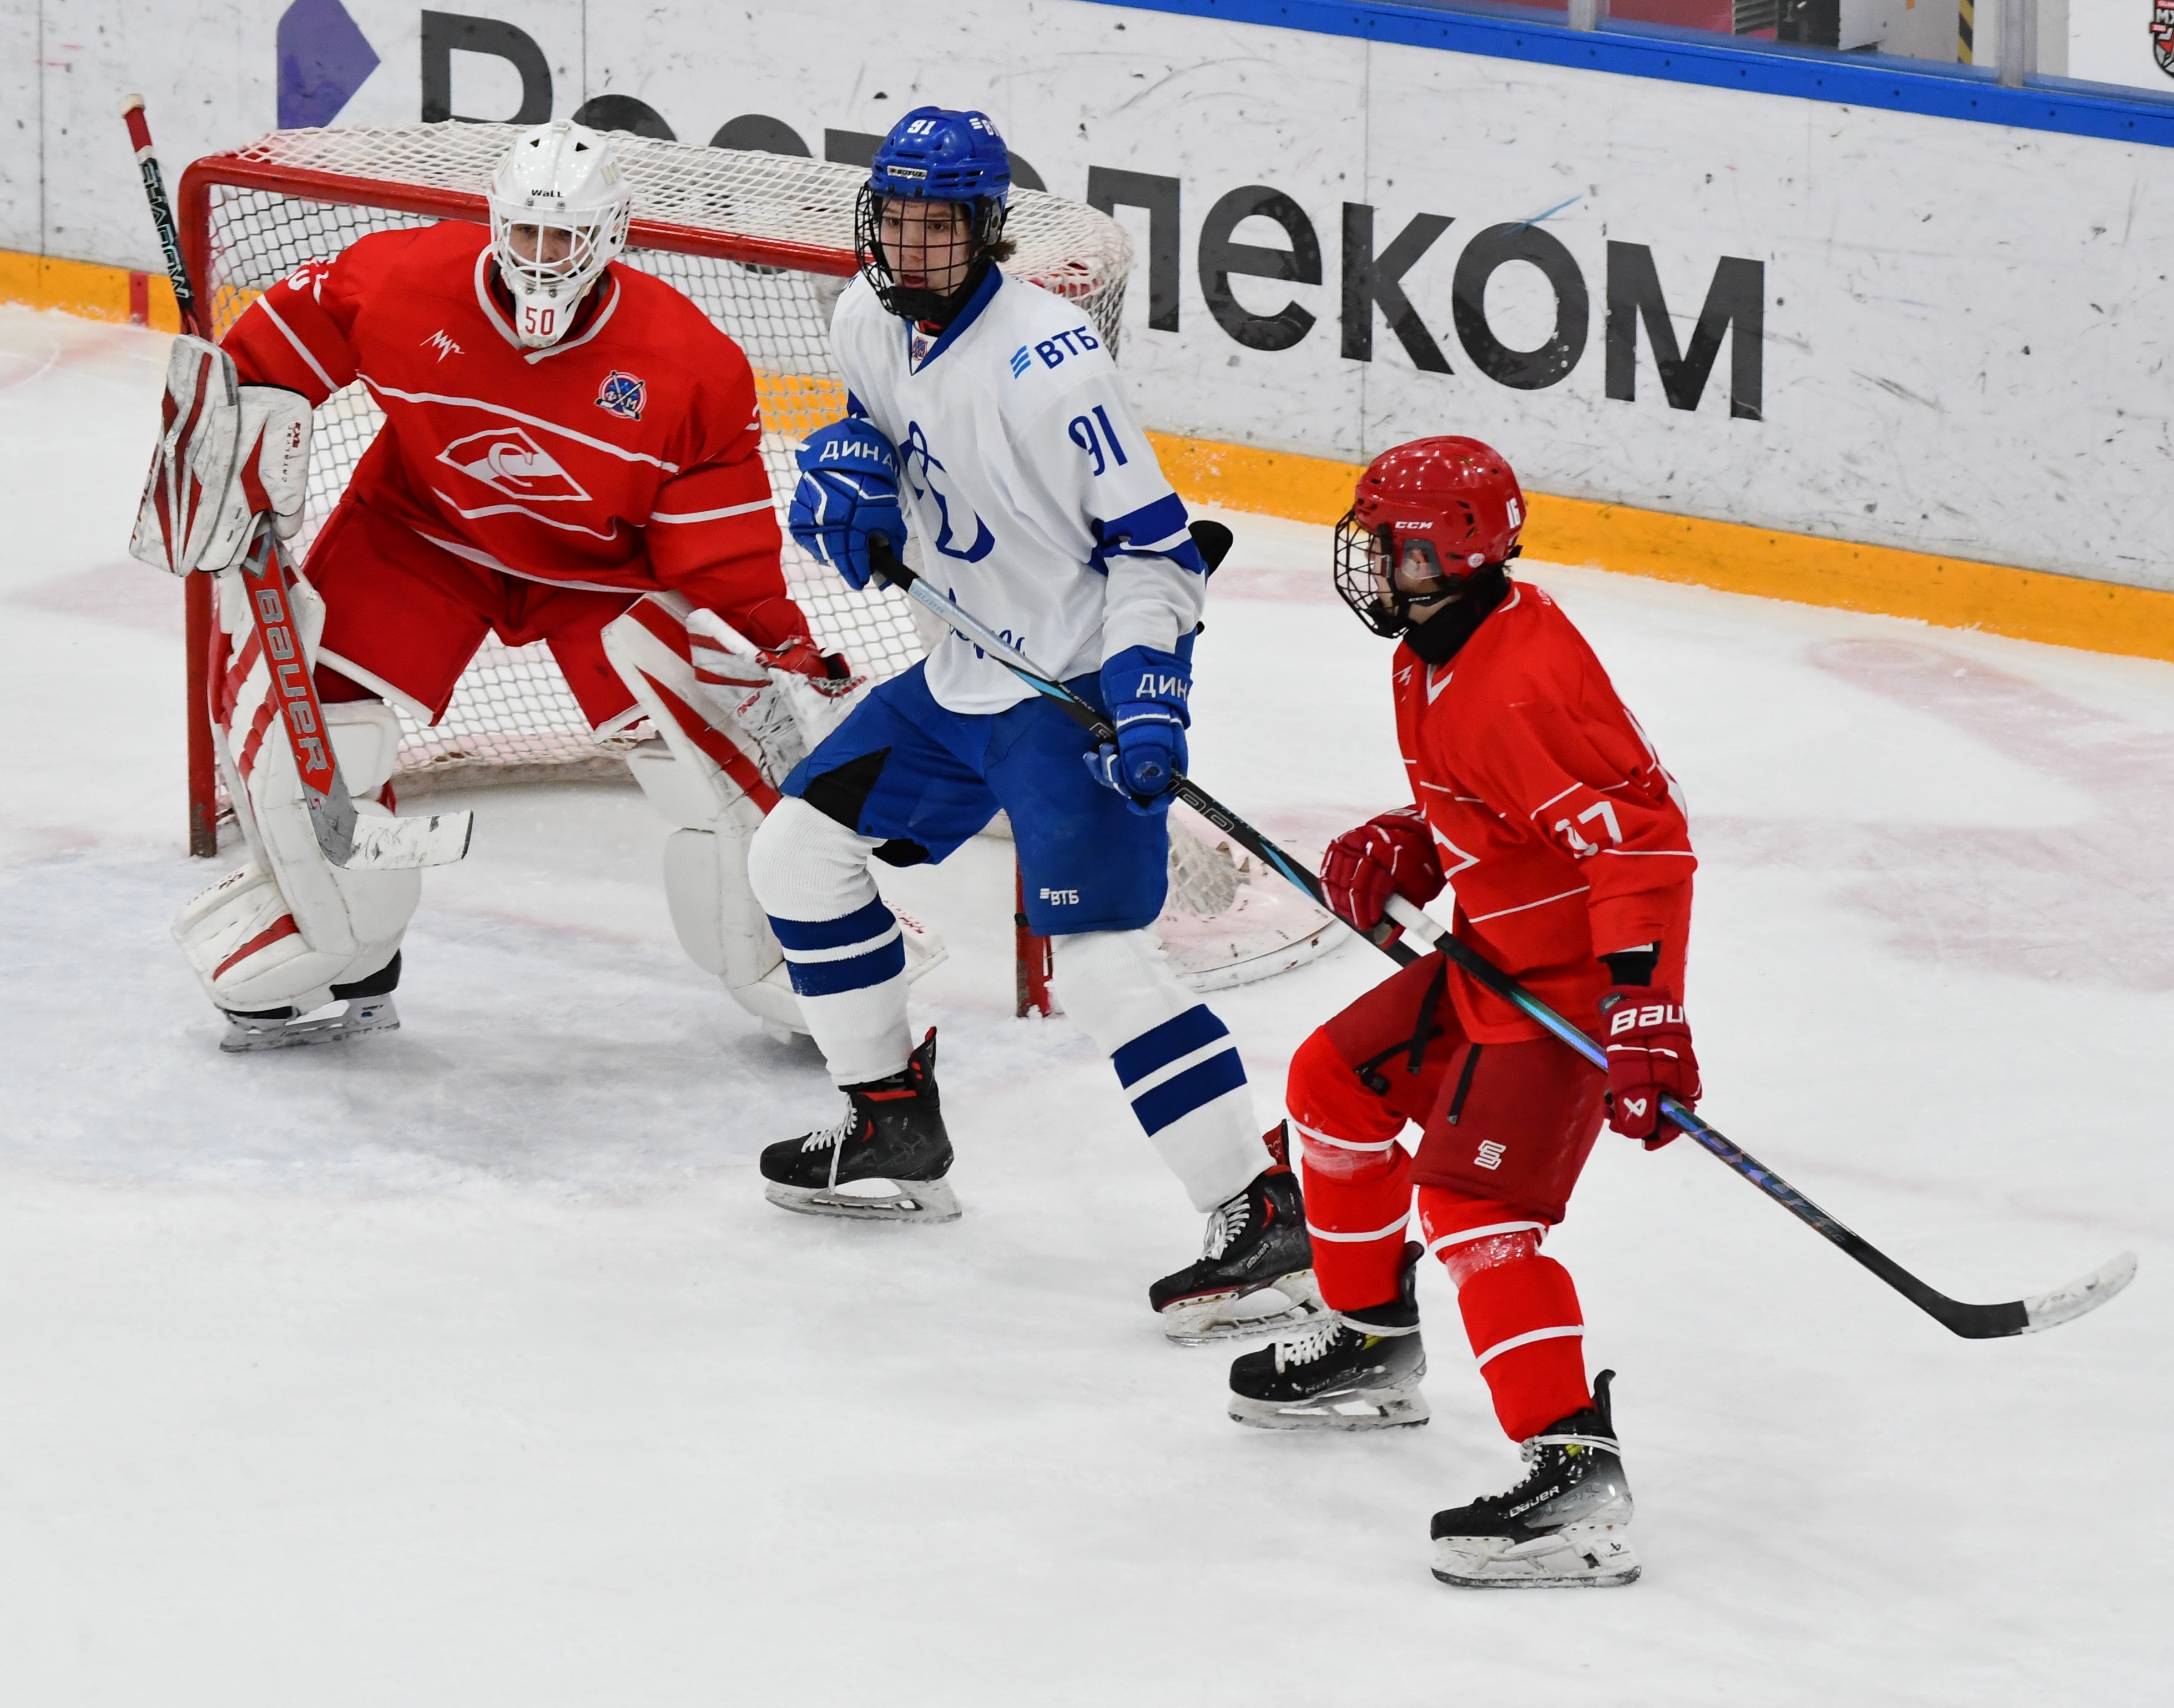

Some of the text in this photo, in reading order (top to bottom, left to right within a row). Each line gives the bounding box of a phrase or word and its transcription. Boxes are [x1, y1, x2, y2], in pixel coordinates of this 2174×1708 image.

[907, 120, 936, 135] 91
[525, 306, 554, 335] 50
[1034, 325, 1099, 369] ВТБ
[1068, 404, 1128, 477] 91
[1395, 521, 1434, 529] CCM
[1506, 497, 1521, 529] 16
[1051, 889, 1080, 905] ВТБ
